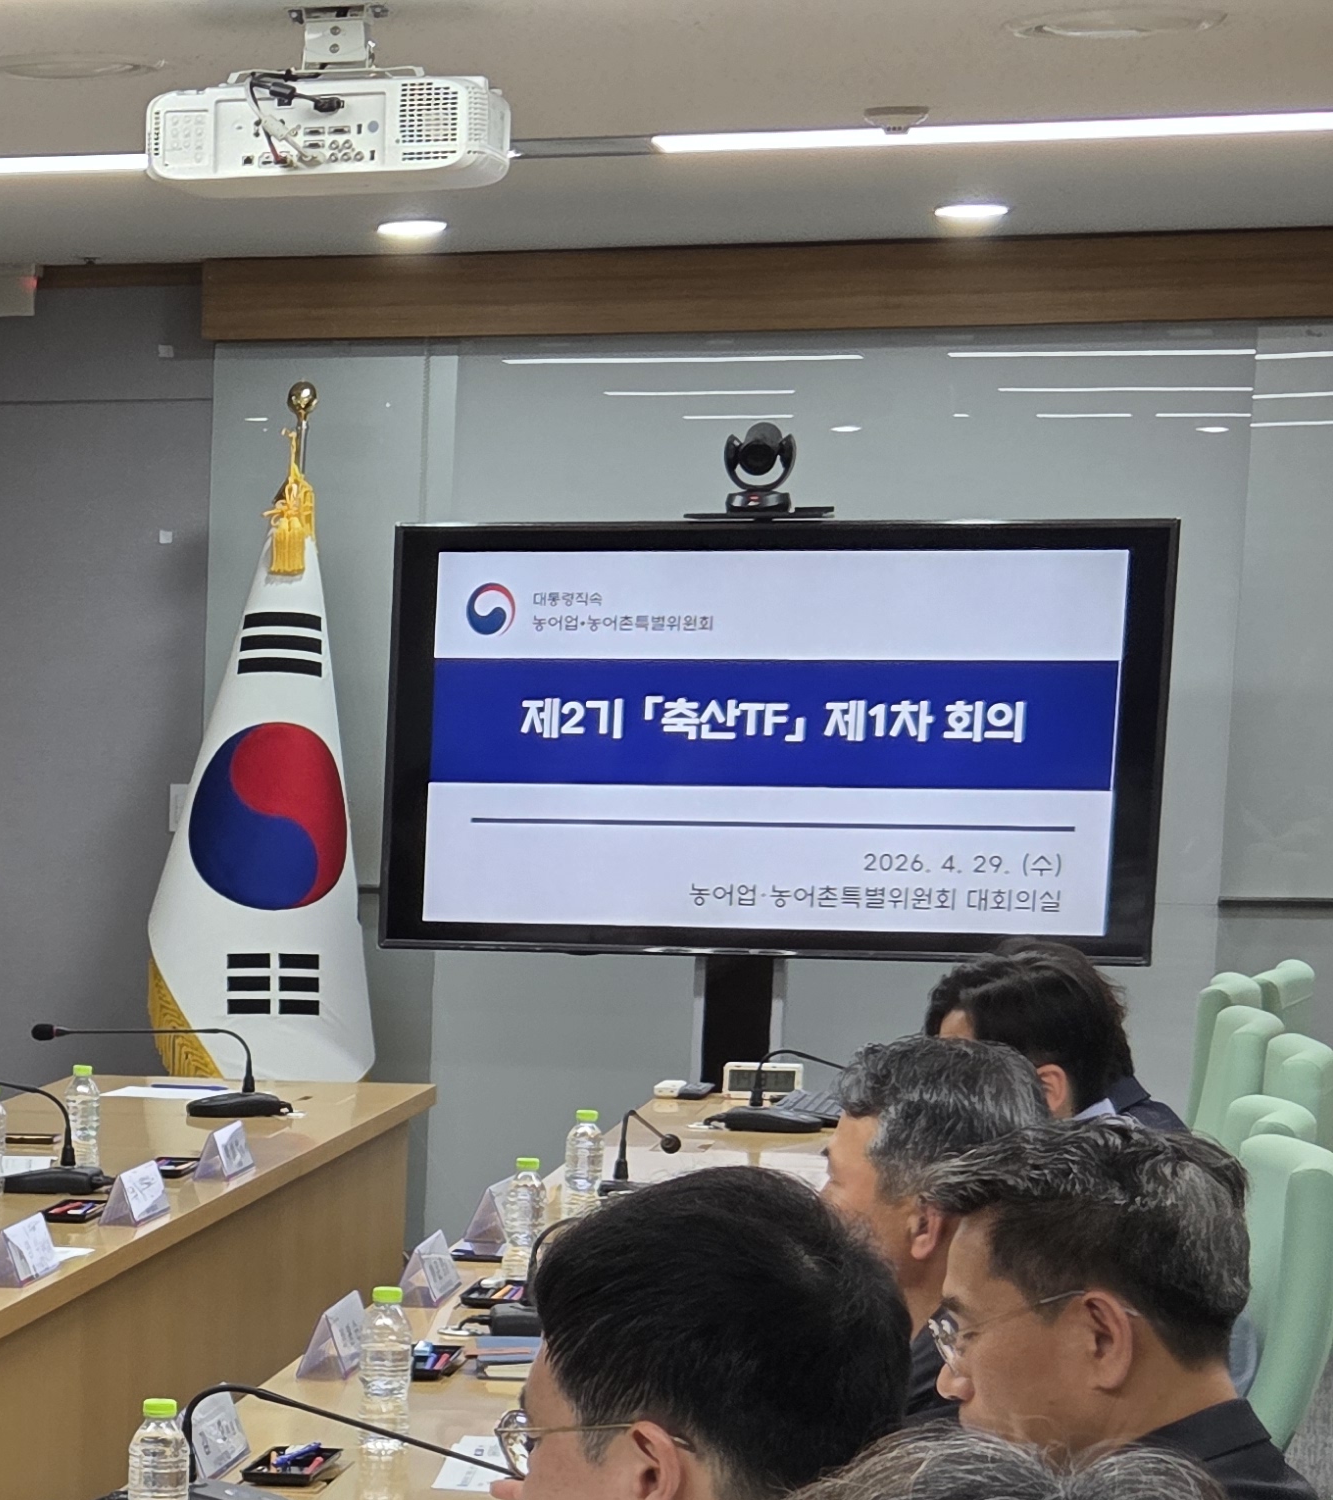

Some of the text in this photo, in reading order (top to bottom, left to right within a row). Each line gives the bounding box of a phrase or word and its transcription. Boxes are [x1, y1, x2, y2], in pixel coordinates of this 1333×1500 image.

[533, 592, 603, 606] 대통령직속
[520, 696, 1025, 743] 제2기 「축산TF」 제1차 회의
[863, 853, 1062, 877] 2026. 4. 29. (수)
[967, 888, 1062, 913] 대회의실
